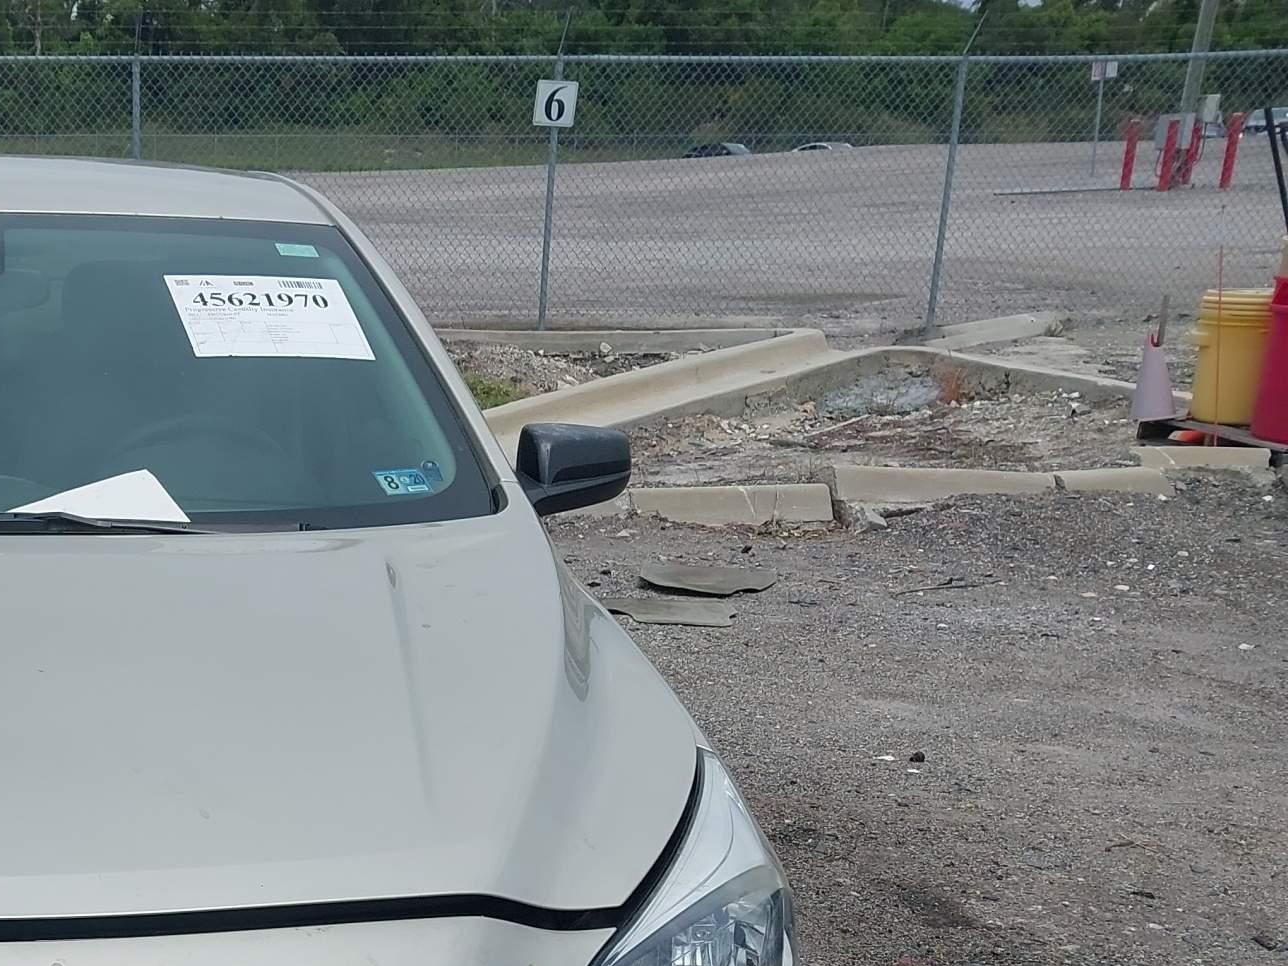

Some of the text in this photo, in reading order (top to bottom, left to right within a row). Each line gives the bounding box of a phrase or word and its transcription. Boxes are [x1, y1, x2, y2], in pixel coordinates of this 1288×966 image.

[544, 85, 569, 122] 6
[192, 291, 329, 309] 45621970
[383, 475, 400, 490] 8
